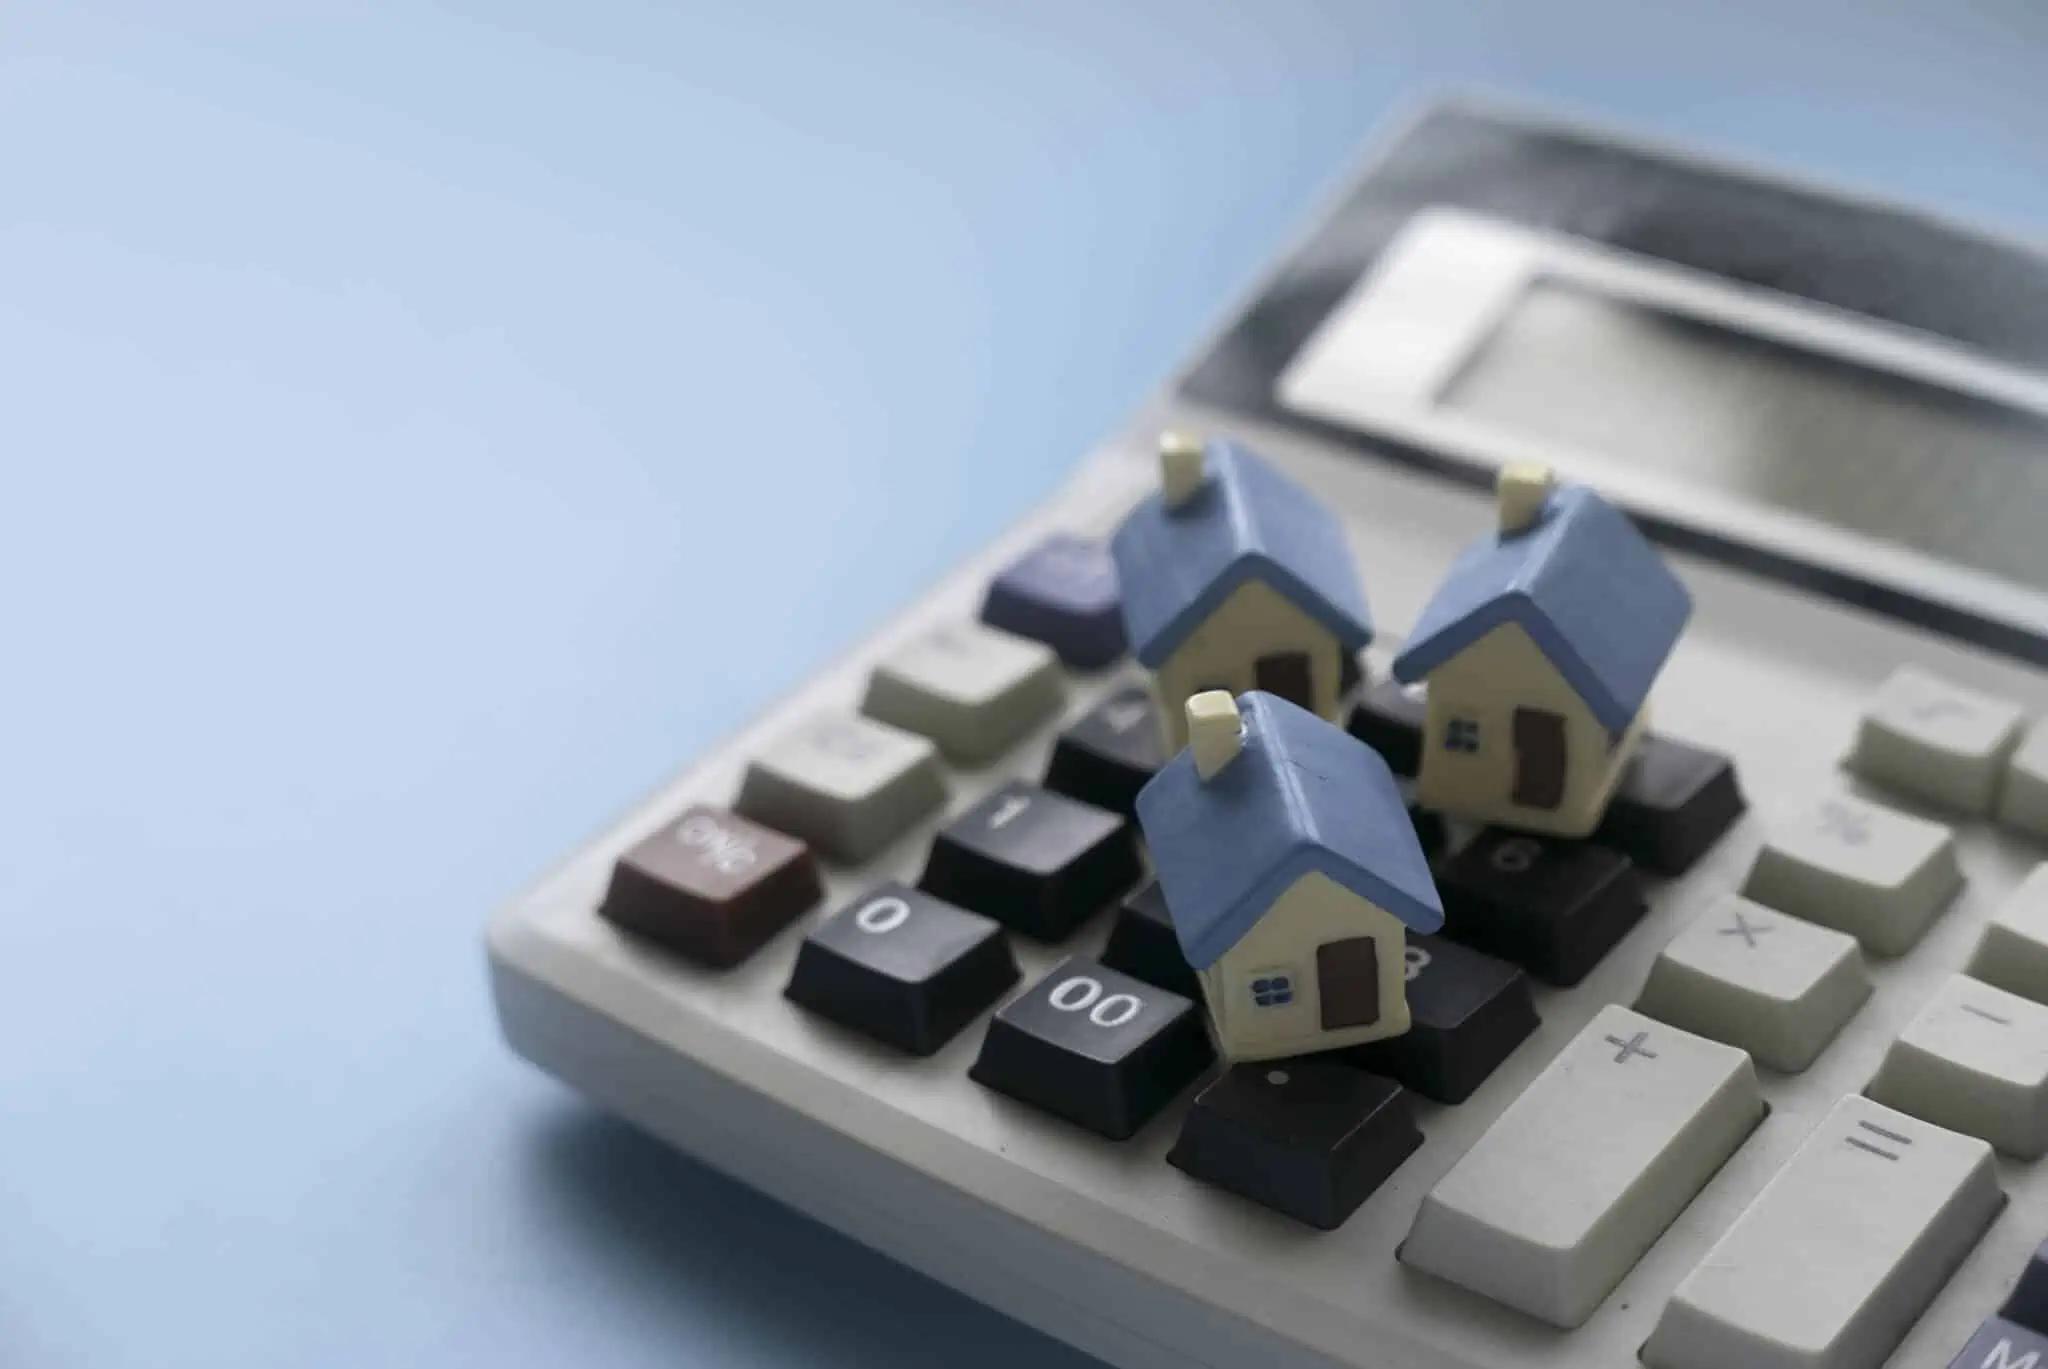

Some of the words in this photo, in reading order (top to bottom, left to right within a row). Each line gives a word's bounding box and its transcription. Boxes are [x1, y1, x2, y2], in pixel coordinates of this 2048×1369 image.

[988, 796, 1031, 831] 1
[1491, 839, 1544, 873] 6
[856, 896, 911, 934] 0
[1049, 976, 1142, 1027] 00
